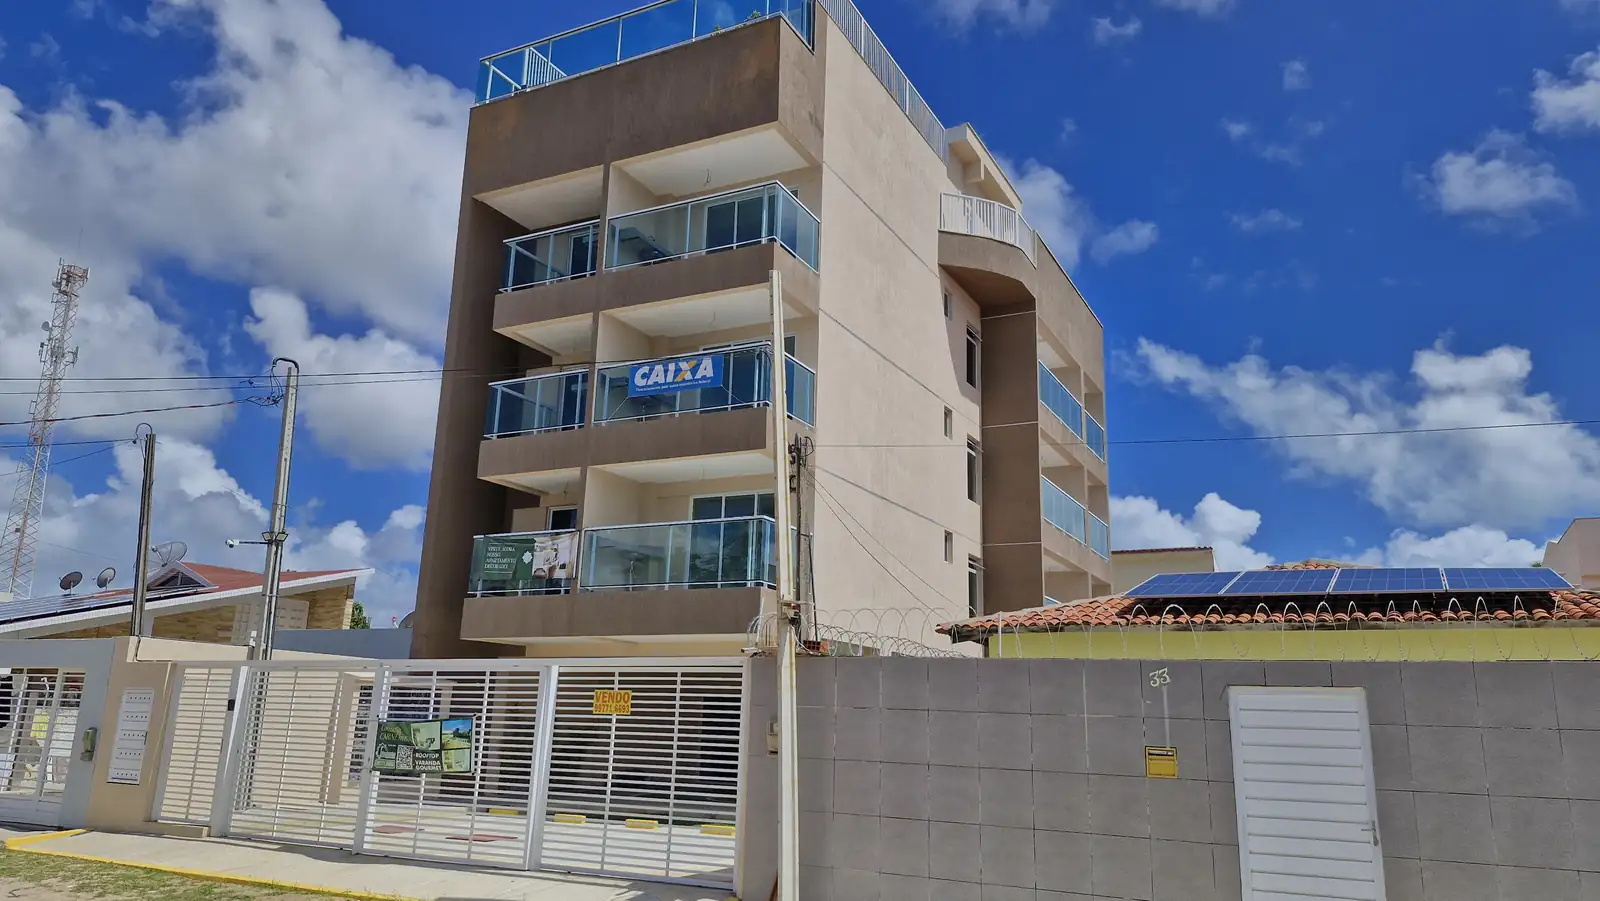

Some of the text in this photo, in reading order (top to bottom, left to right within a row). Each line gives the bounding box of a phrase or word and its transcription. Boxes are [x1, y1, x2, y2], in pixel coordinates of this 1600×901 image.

[634, 357, 714, 387] CAIXA
[1149, 667, 1171, 687] 33
[595, 691, 630, 704] VENDO
